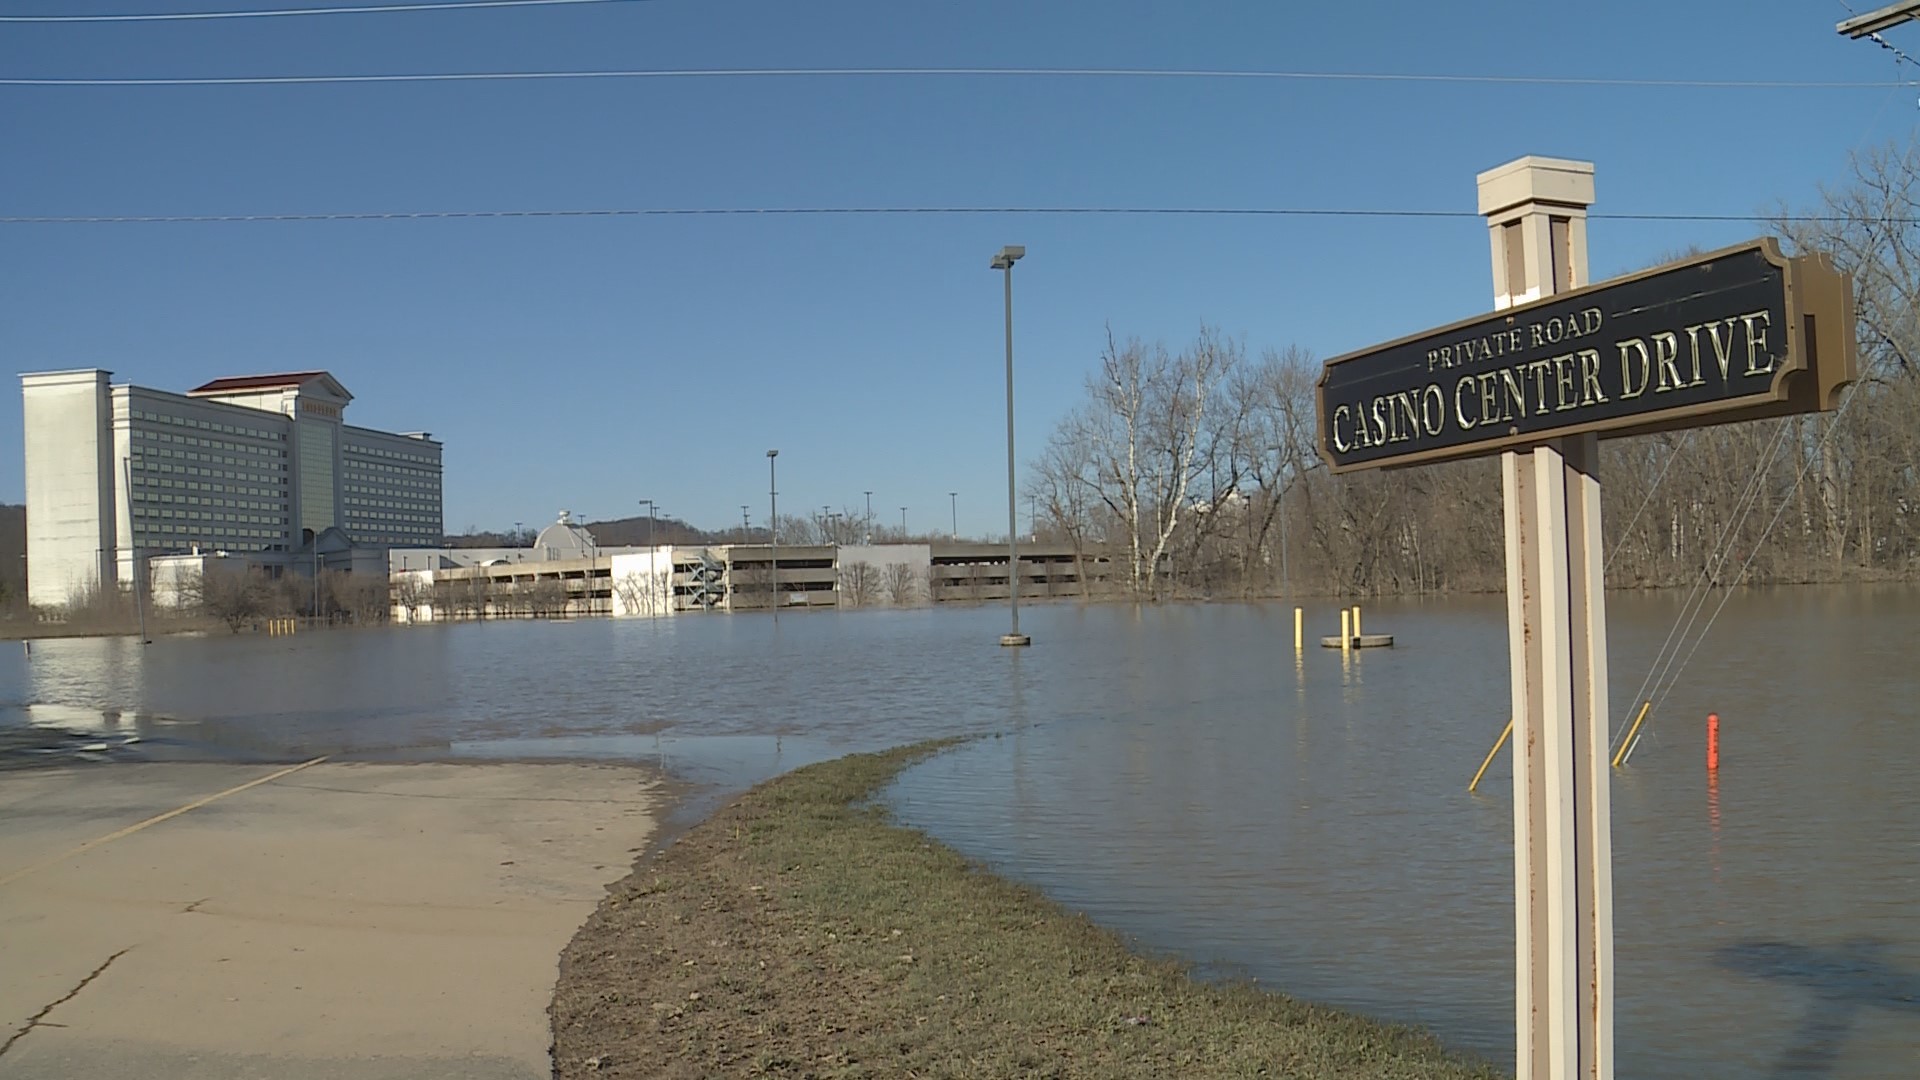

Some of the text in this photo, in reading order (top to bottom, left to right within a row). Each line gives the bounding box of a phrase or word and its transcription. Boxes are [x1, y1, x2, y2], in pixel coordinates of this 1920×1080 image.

[1333, 310, 1775, 453] CASINO CENTER DRIVE
[1427, 307, 1603, 373] PRIVATE ROAD
